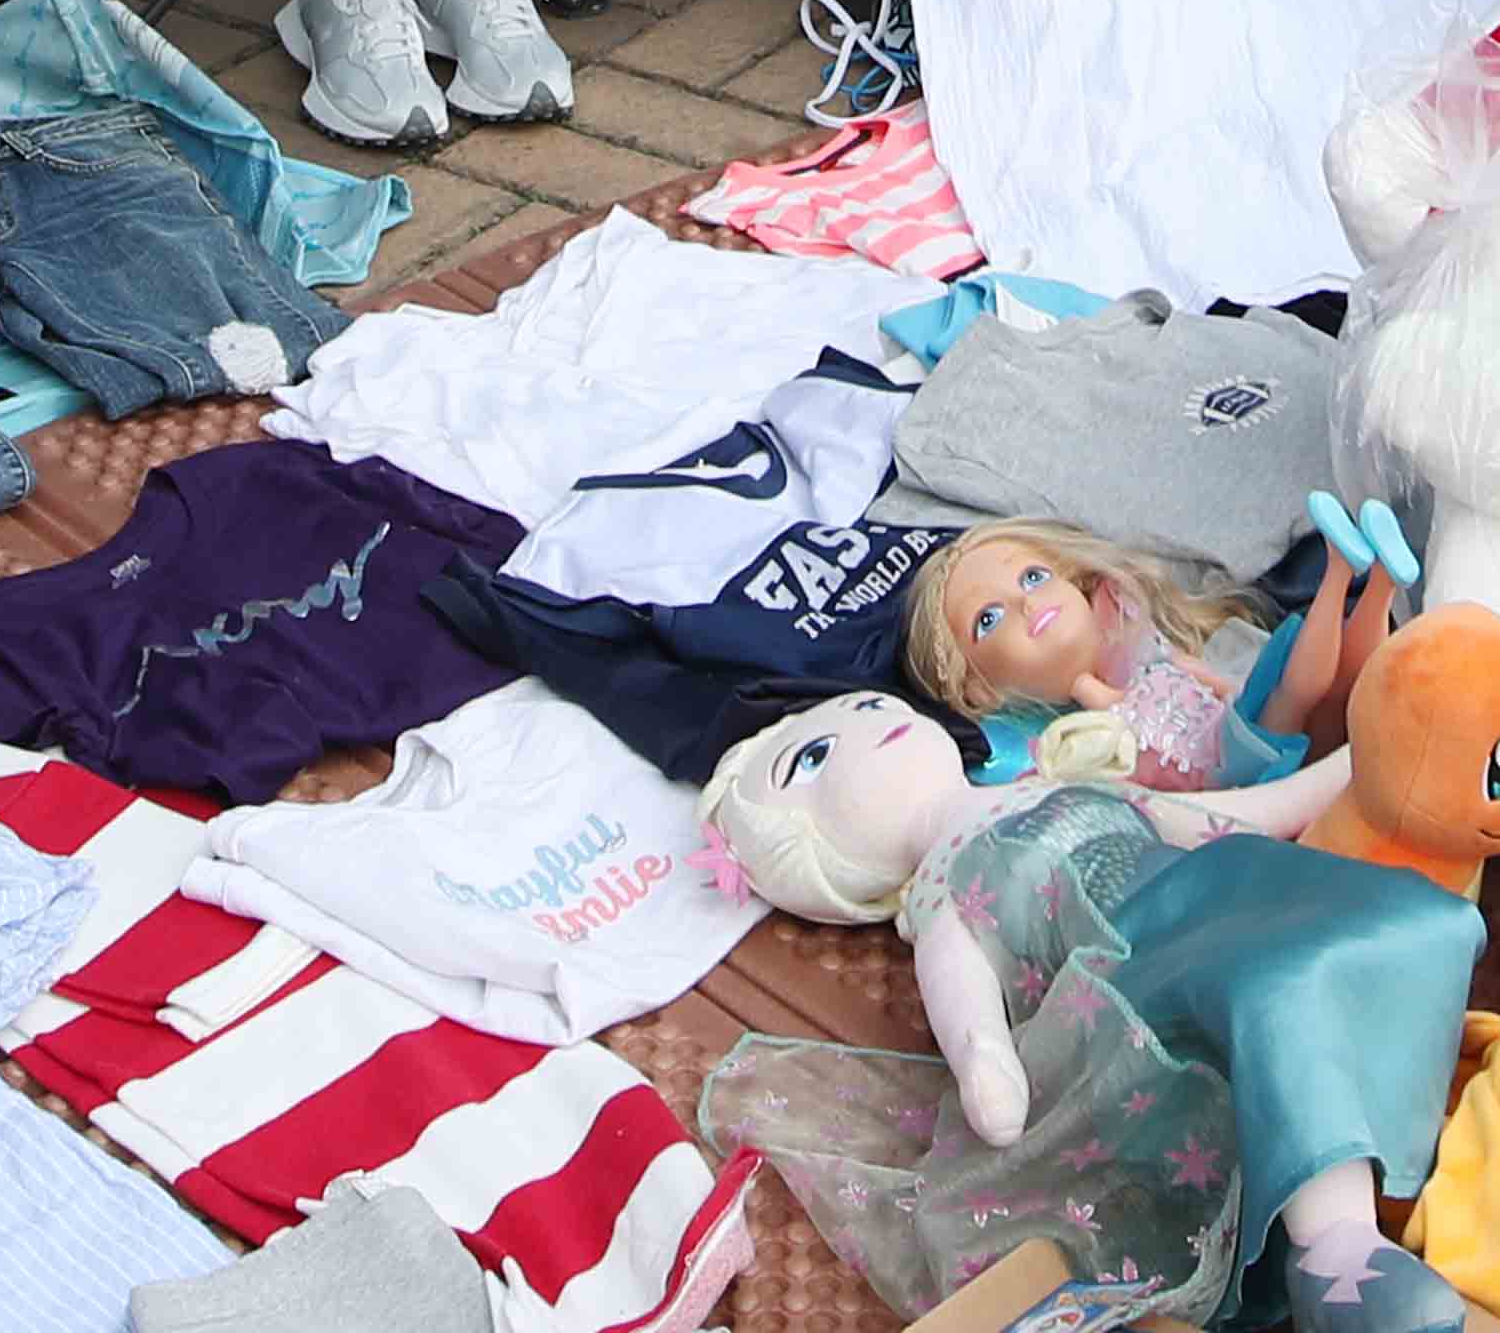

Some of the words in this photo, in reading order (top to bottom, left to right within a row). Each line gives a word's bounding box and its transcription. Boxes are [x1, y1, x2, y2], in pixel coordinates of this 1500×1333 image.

[743, 526, 887, 612] EAS
[835, 546, 912, 613] WORLD
[903, 529, 940, 557] BE
